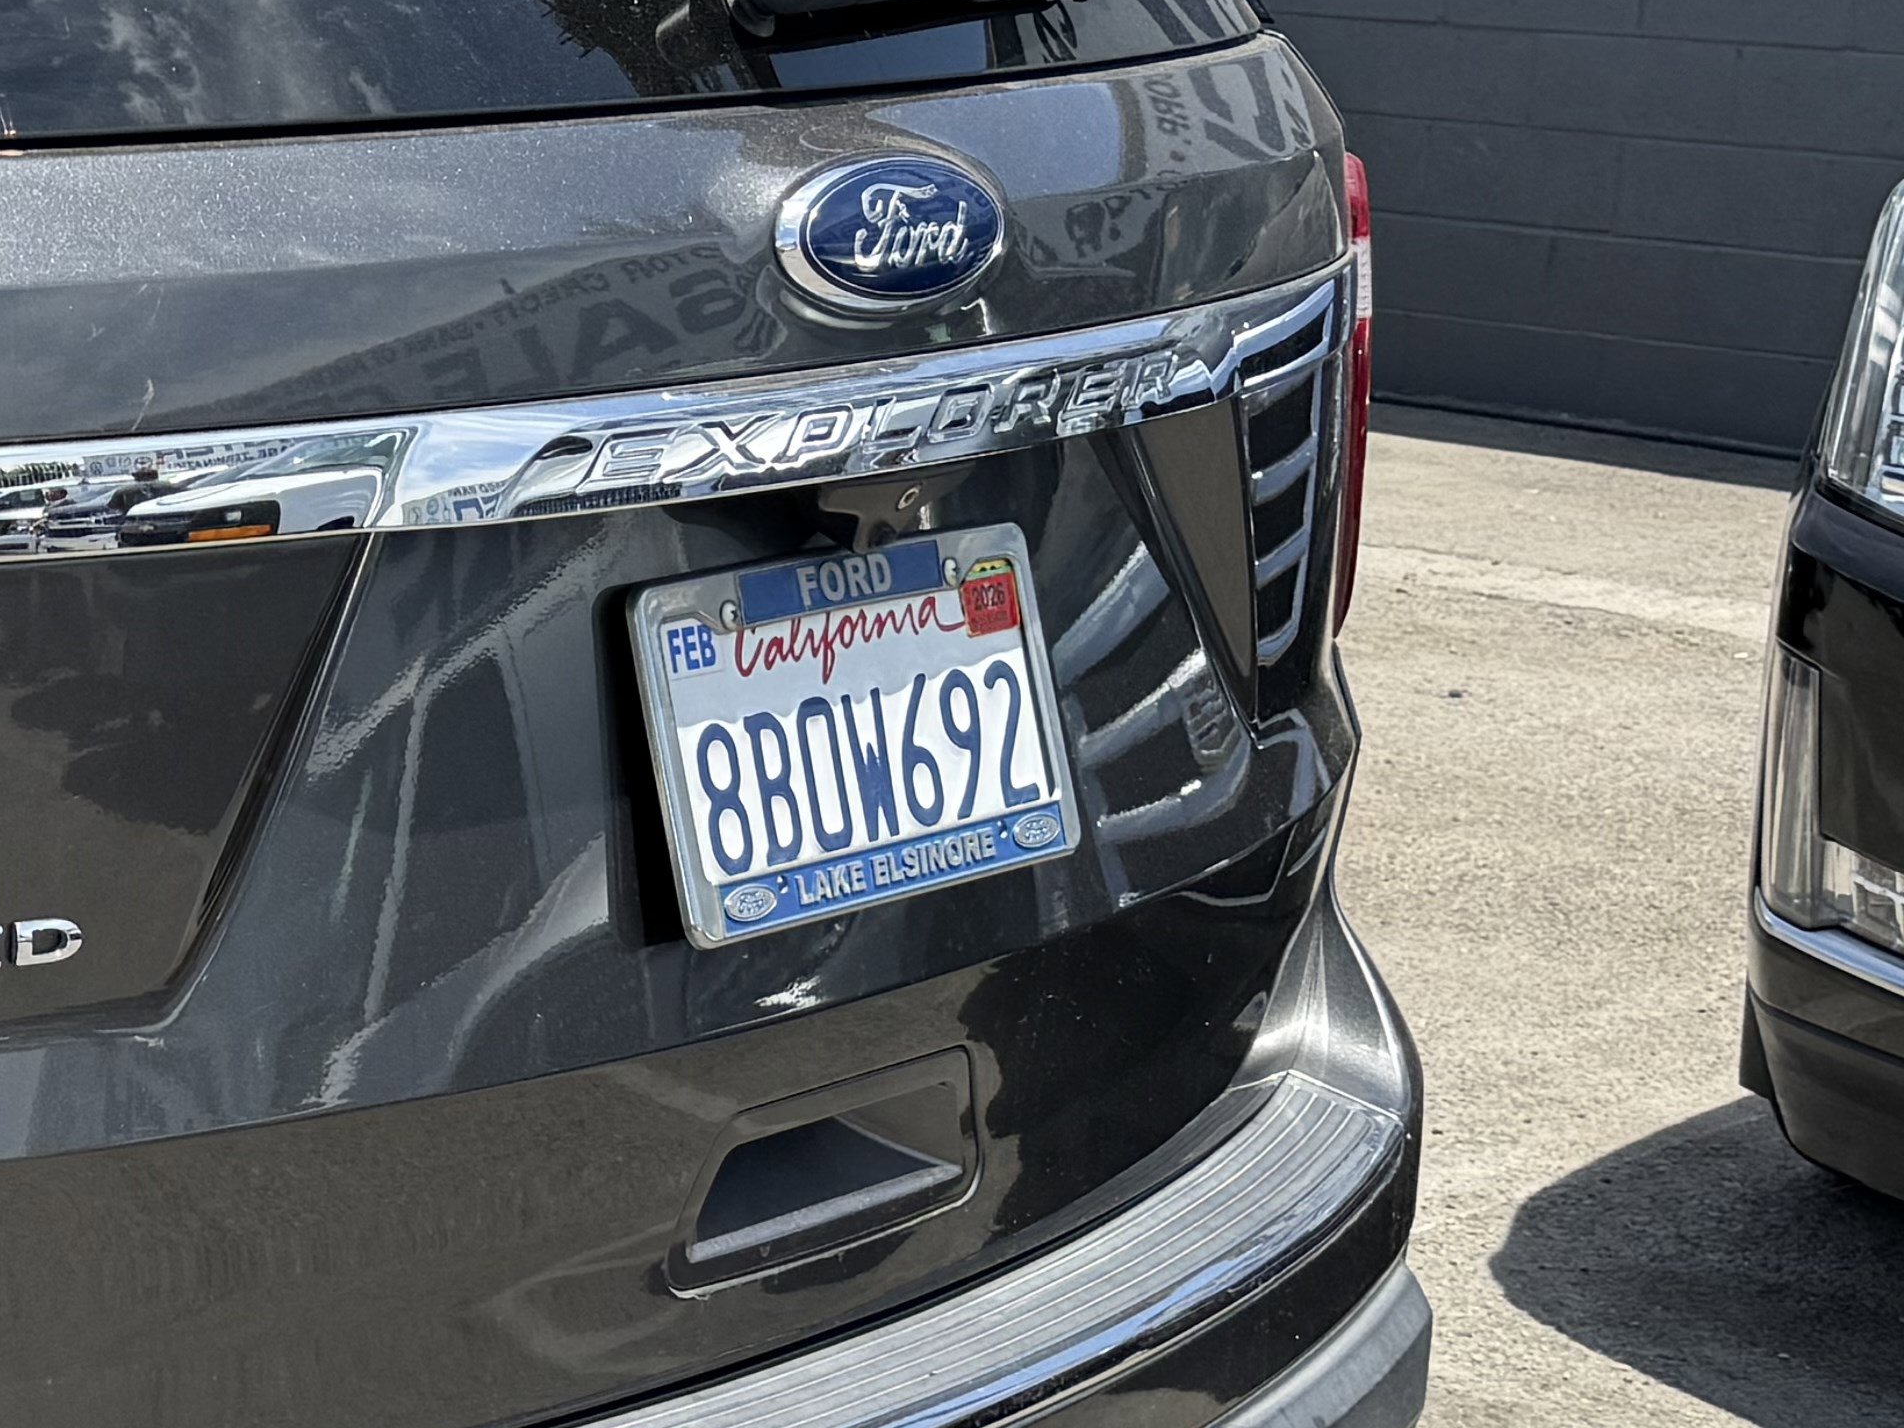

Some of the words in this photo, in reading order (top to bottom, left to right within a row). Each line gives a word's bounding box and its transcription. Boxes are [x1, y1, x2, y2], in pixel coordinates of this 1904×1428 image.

[853, 182, 968, 273] Ford
[582, 351, 1181, 484] EXPLORER
[796, 553, 892, 608] FORD
[970, 581, 1006, 611] 2026
[667, 622, 717, 674] FEB
[734, 595, 965, 684] California
[794, 859, 864, 906] LAKE
[874, 825, 998, 888] ELSINORE
